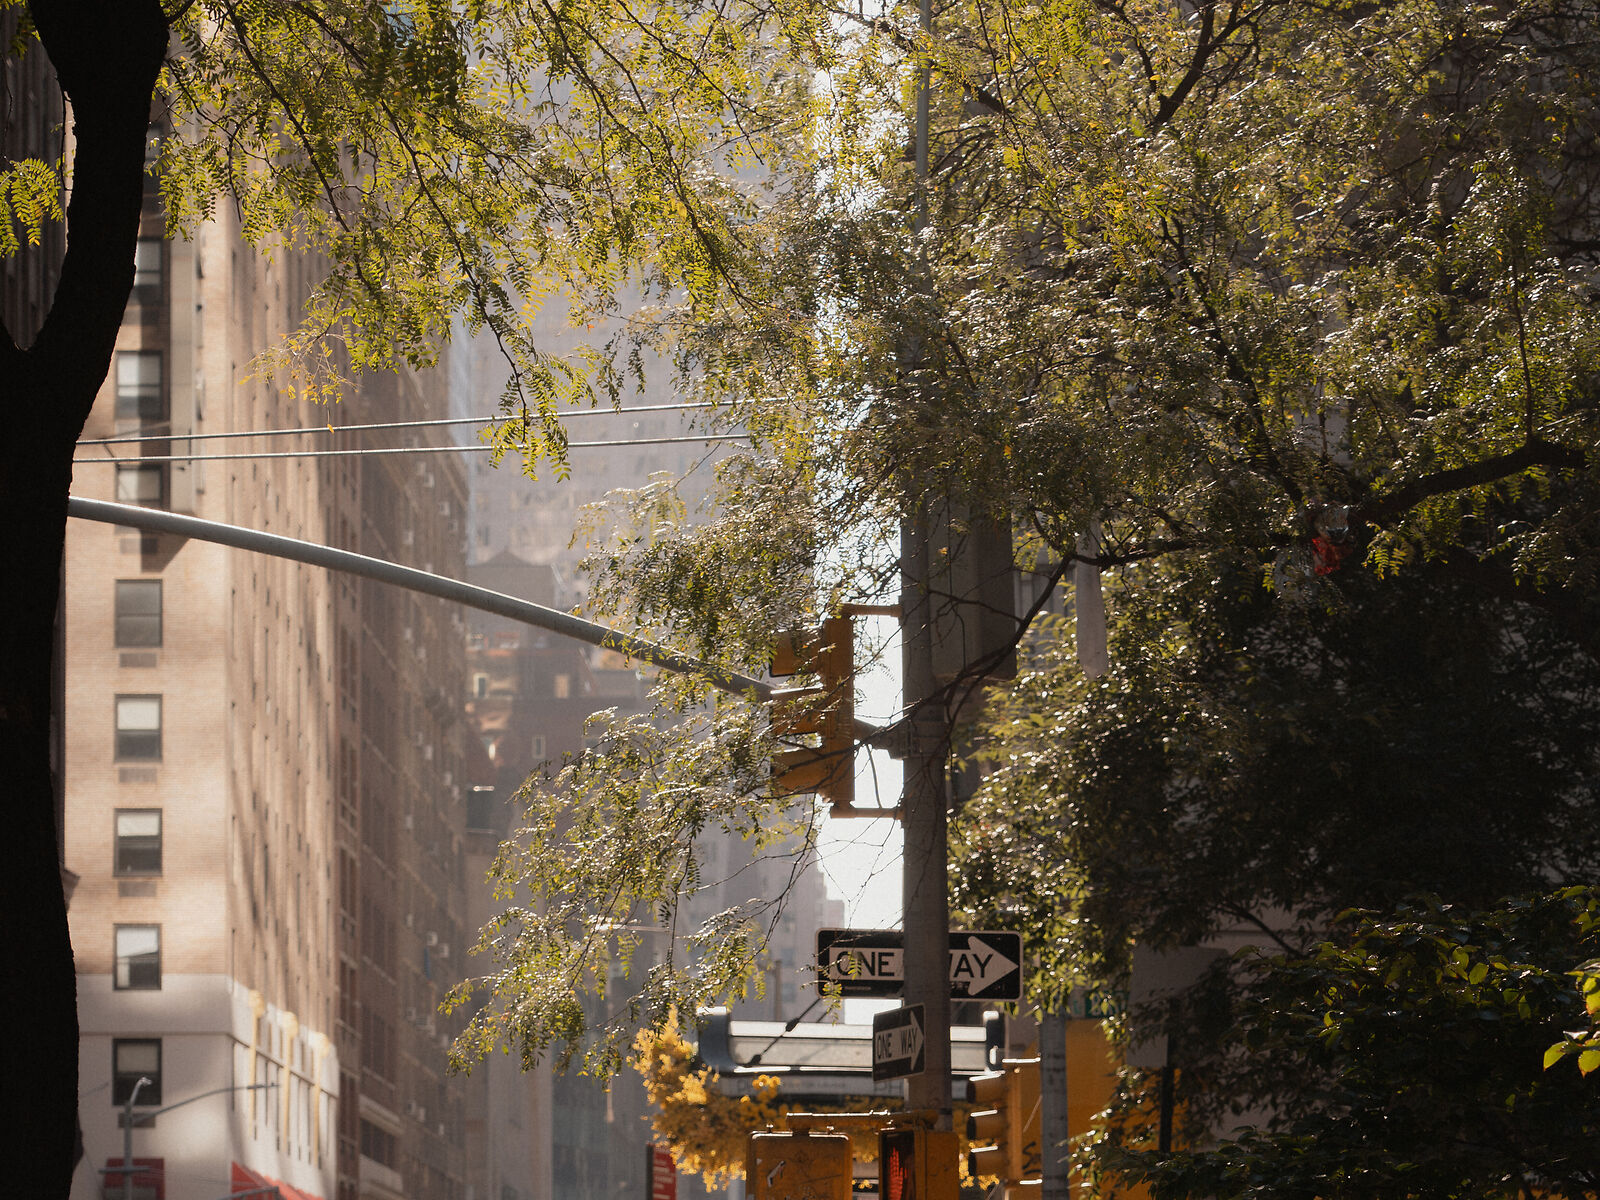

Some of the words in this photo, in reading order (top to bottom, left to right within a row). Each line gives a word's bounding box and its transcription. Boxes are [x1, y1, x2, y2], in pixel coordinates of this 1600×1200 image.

[836, 951, 895, 977] ONE
[877, 1033, 893, 1059] ONE
[901, 1027, 918, 1056] WAY
